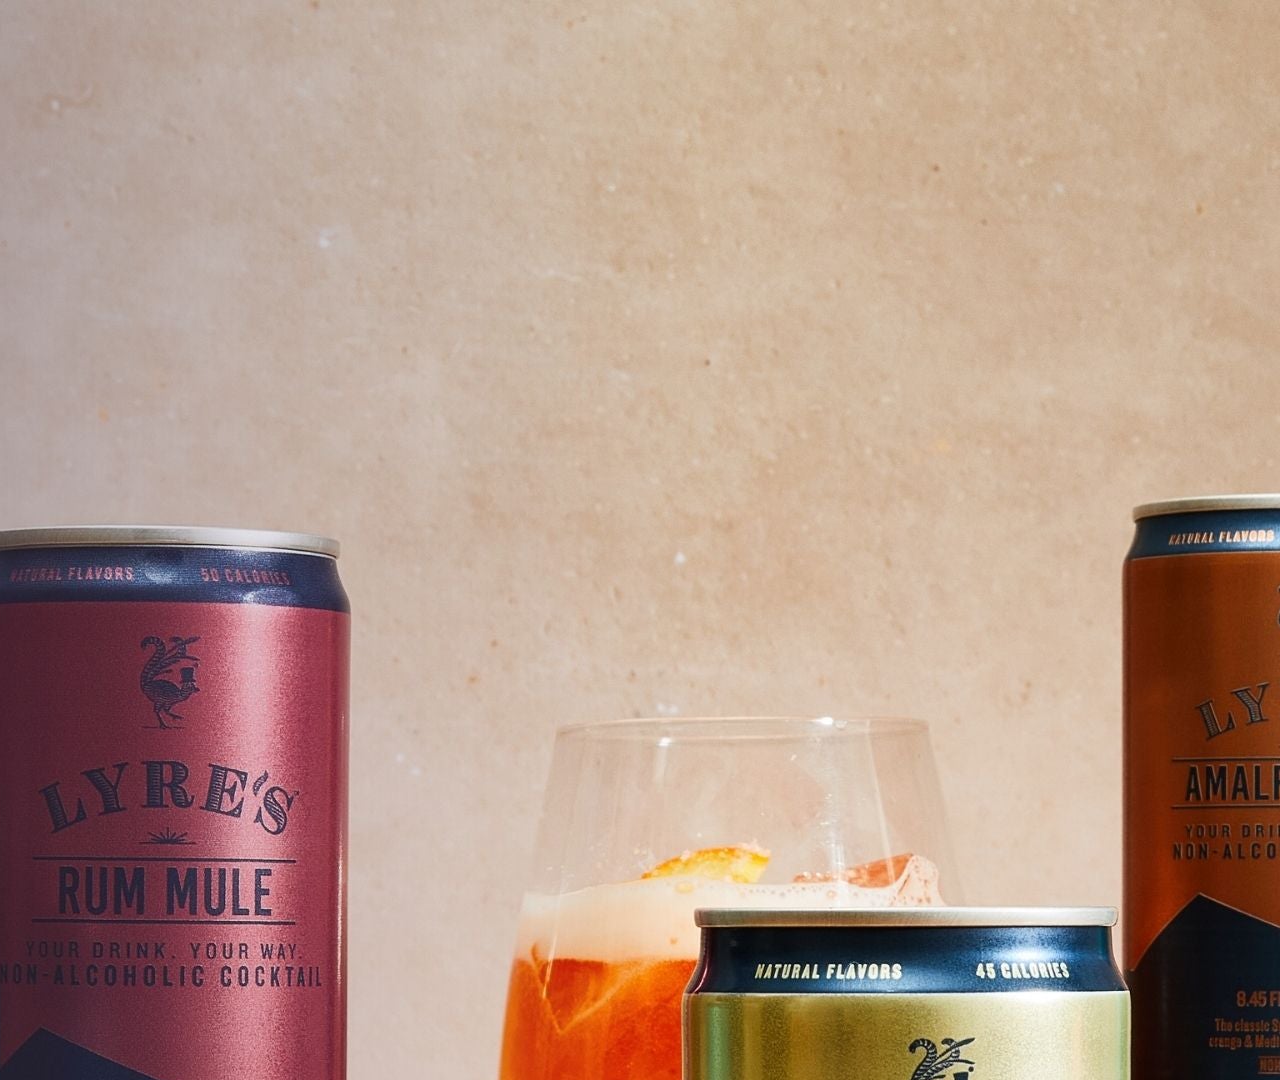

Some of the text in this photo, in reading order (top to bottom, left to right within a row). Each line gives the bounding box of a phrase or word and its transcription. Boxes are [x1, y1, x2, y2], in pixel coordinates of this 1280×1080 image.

[1169, 529, 1275, 545] NATURAL FLAVORS
[9, 566, 135, 583] NATURAL FLAVORS
[201, 568, 291, 586] 50 CALORIES
[39, 760, 296, 836] LYRE'S
[1184, 825, 1231, 838] YOUR
[58, 866, 272, 916] RUM MULE
[25, 941, 303, 959] YOUR DRINK. YOUR WAY.
[0, 964, 322, 987] NON-ALCOHOLIC COCKTAIL
[754, 963, 902, 980] NATURAL FLAVORS
[976, 961, 1070, 979] 45 CALORIES
[1236, 991, 1267, 1007] 8.45
[1214, 1018, 1232, 1032] The
[1235, 1019, 1270, 1032] classic
[1209, 1037, 1242, 1050] orange
[1244, 1035, 1252, 1048] &
